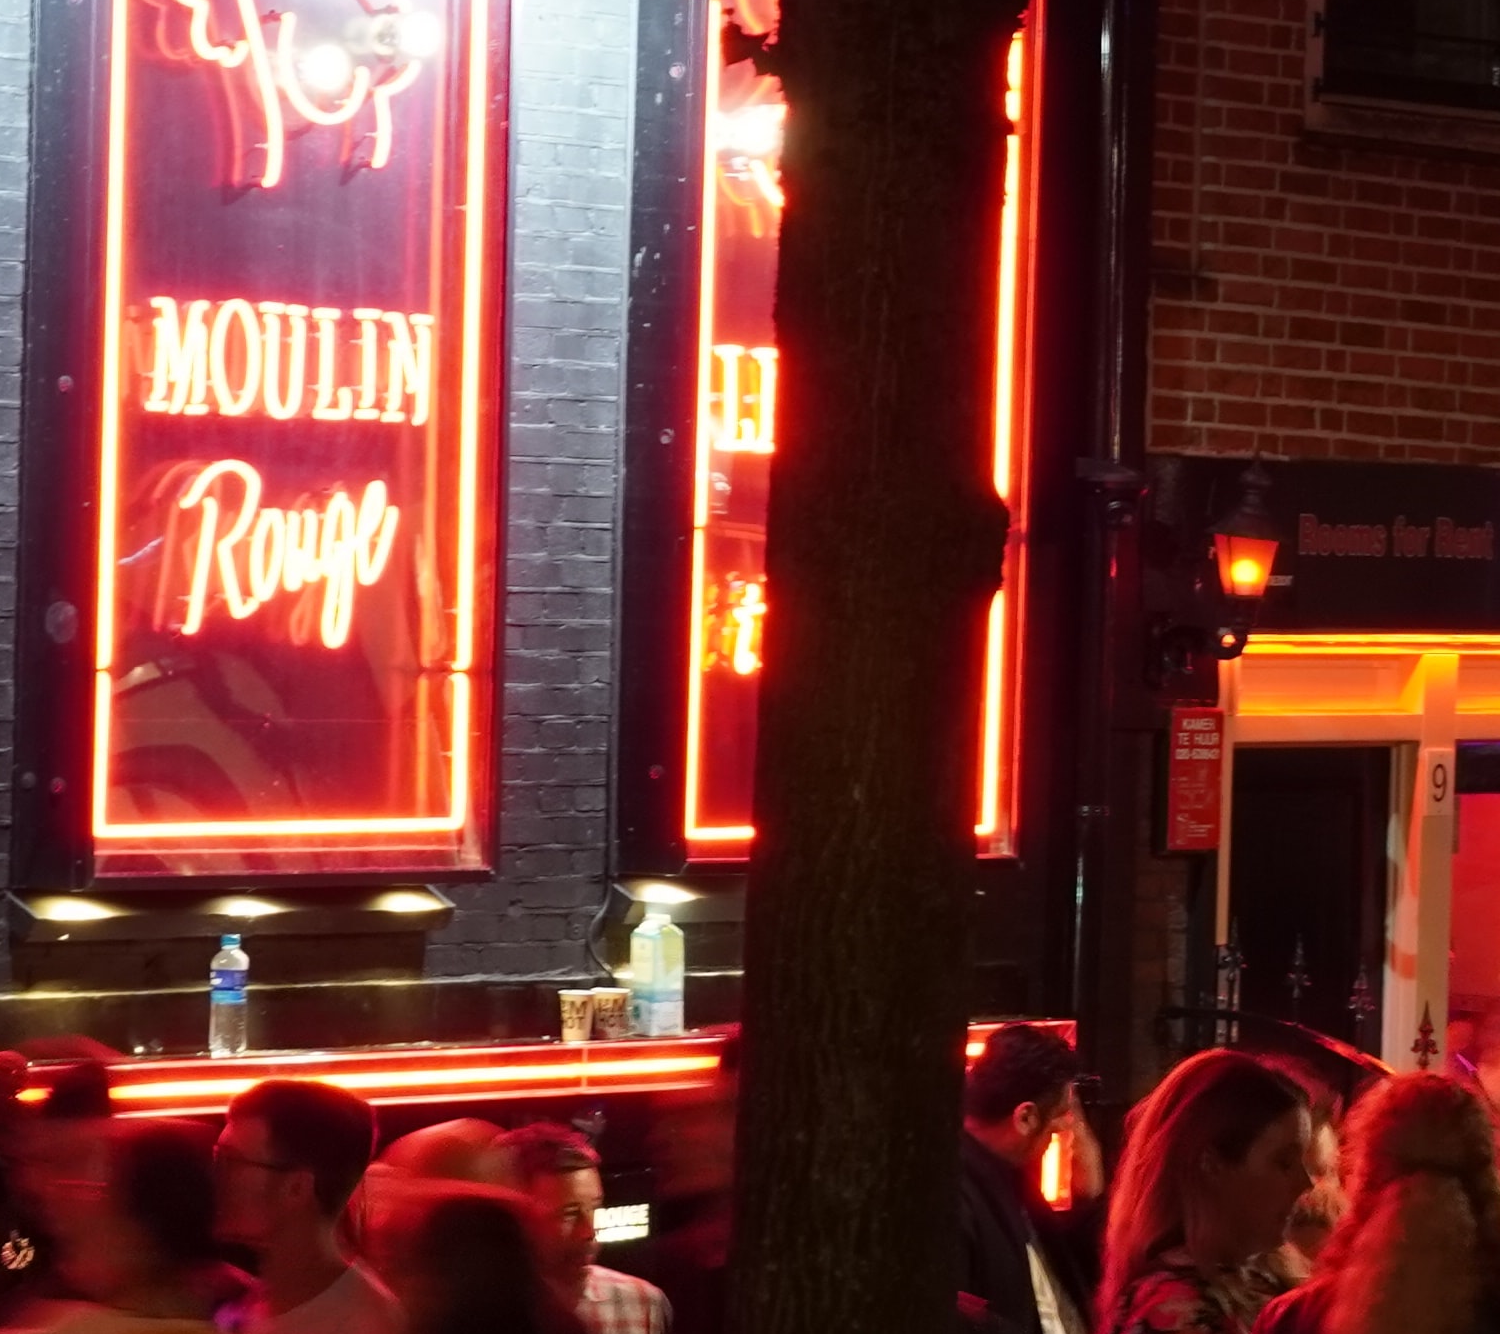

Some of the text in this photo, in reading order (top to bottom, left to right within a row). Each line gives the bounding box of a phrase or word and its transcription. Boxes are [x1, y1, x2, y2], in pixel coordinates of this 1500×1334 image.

[144, 296, 435, 427] MOULIN
[179, 458, 400, 650] Rouge
[1297, 513, 1387, 558] Rooms
[1393, 514, 1431, 559] for
[1435, 516, 1495, 561] Rent
[1432, 763, 1447, 802] 9
